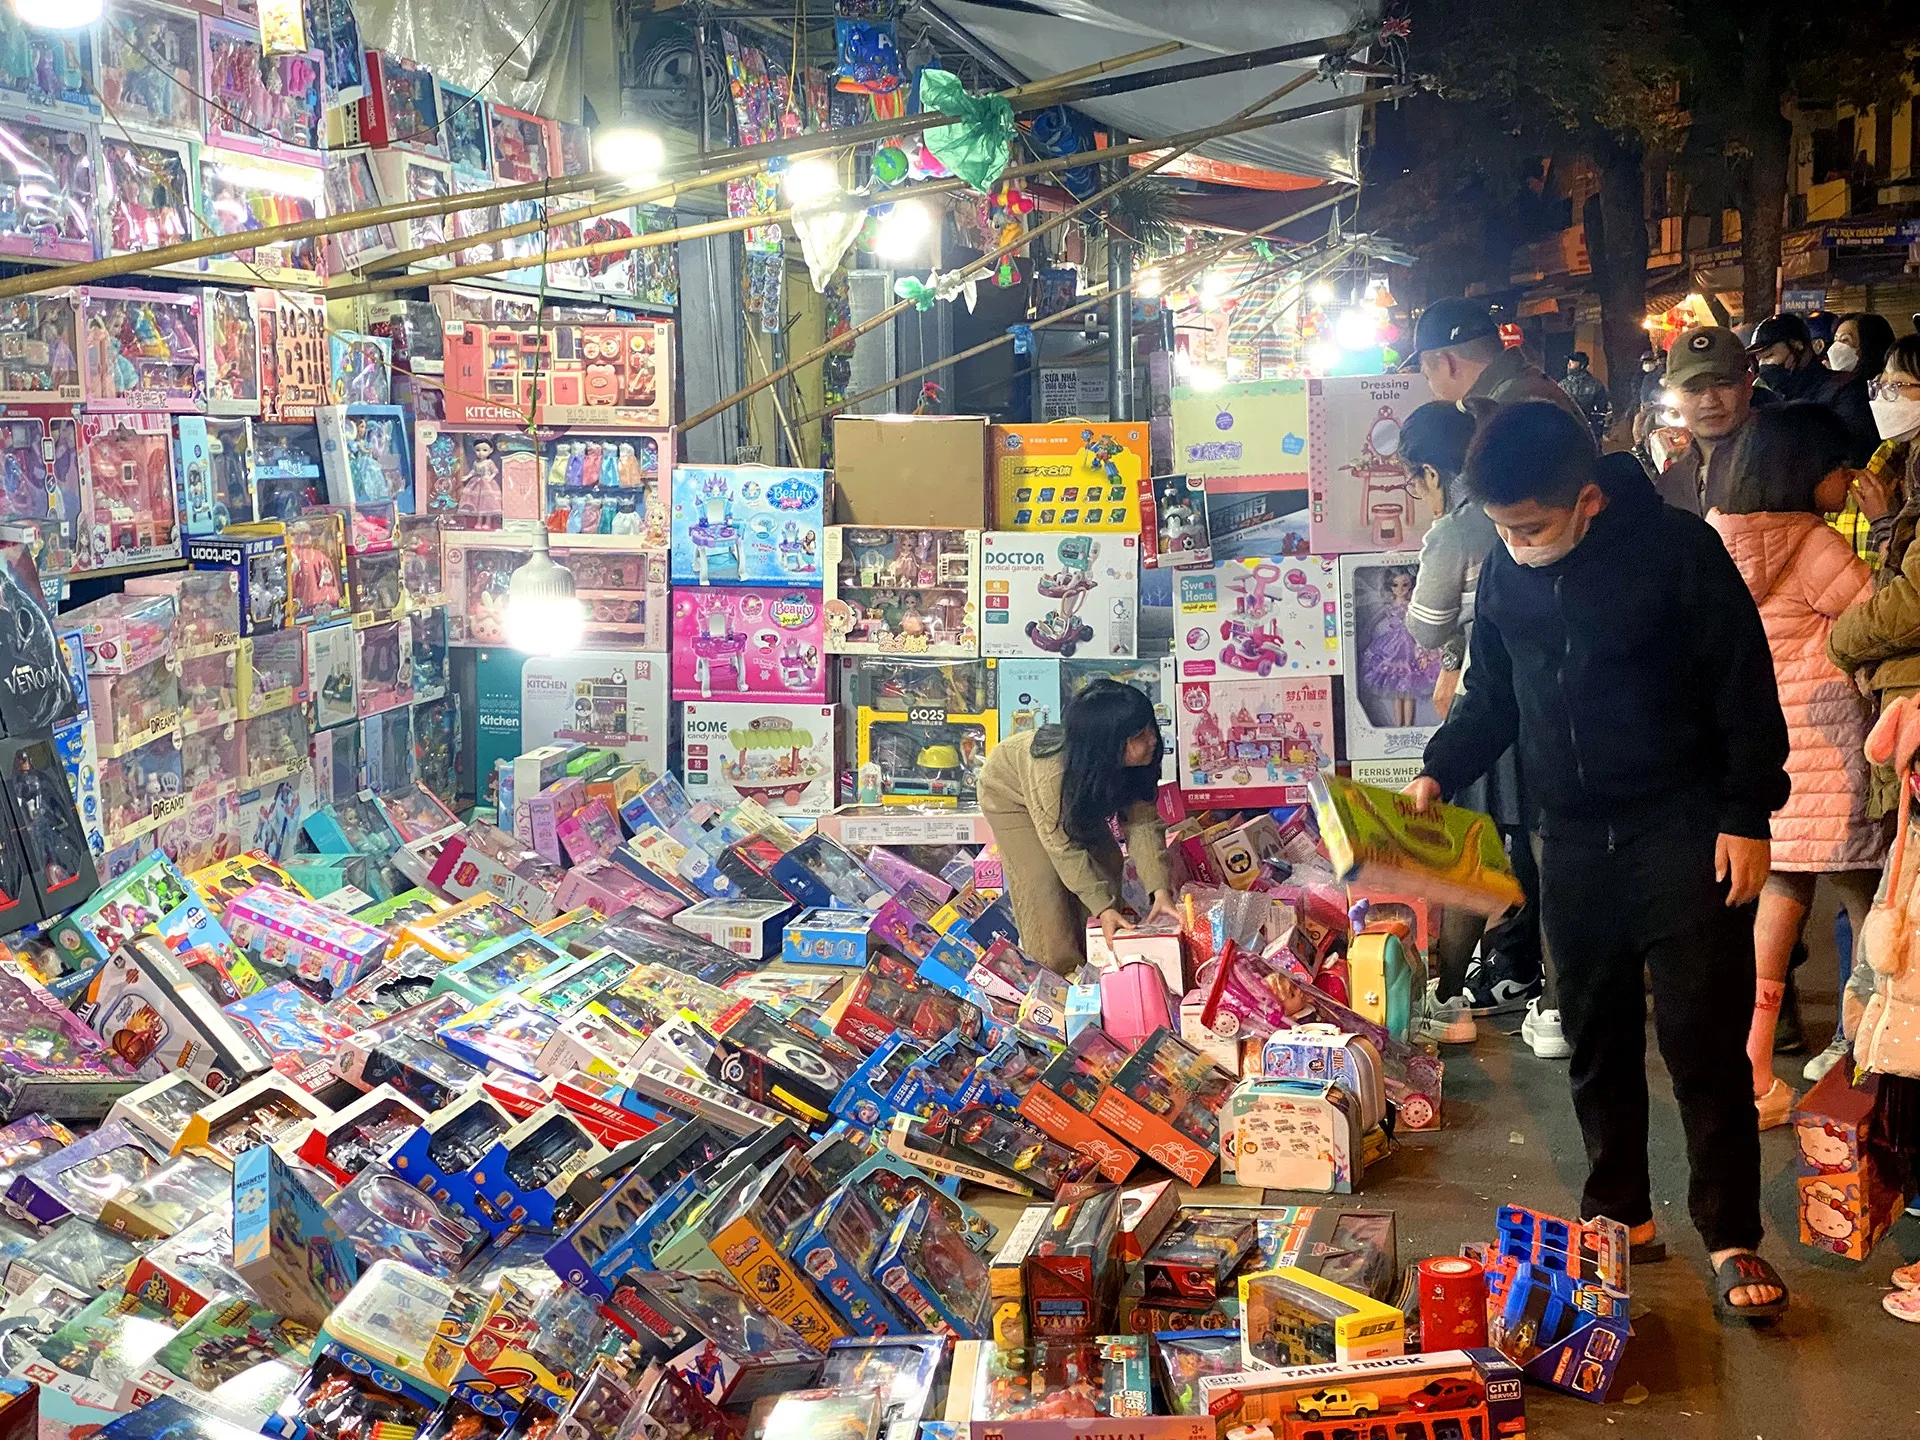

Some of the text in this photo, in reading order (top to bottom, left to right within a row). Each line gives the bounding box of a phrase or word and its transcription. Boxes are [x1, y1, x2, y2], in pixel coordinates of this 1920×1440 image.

[1360, 380, 1409, 393] Dressing
[1370, 390, 1400, 401] Table
[465, 406, 523, 419] KITCHEN
[774, 486, 814, 506] Beauty
[191, 547, 242, 566] Cartoon
[985, 552, 1045, 565] DOCTOR
[985, 564, 1011, 572] medical
[1181, 579, 1216, 591] Sweet
[1185, 590, 1214, 602] Home
[774, 603, 814, 619] Beauty
[637, 661, 649, 671] 89
[4, 660, 62, 695] VENOM
[526, 679, 568, 691] KITCHEN
[149, 711, 178, 735] DREAMY
[479, 715, 520, 728] Kitchen
[686, 720, 728, 733] HOME
[687, 732, 728, 742] candy ship
[1358, 767, 1392, 777] FERRIS
[1358, 776, 1411, 785] CATCHING BALL
[151, 795, 186, 821] DREAMY
[1236, 1098, 1248, 1108] 3+
[586, 1102, 626, 1122] MODEL
[236, 1172, 267, 1190] MAGNETIC
[283, 1165, 320, 1215] MAGNETIC
[612, 1285, 674, 1338] AVENGERS
[1282, 1357, 1426, 1378] TANK TRUCK
[1209, 1376, 1239, 1384] CITY
[1488, 1382, 1518, 1394] CITY
[1489, 1391, 1519, 1400] SERVICE
[1211, 1393, 1239, 1412] TRY ME
[1191, 1424, 1205, 1434] 3+
